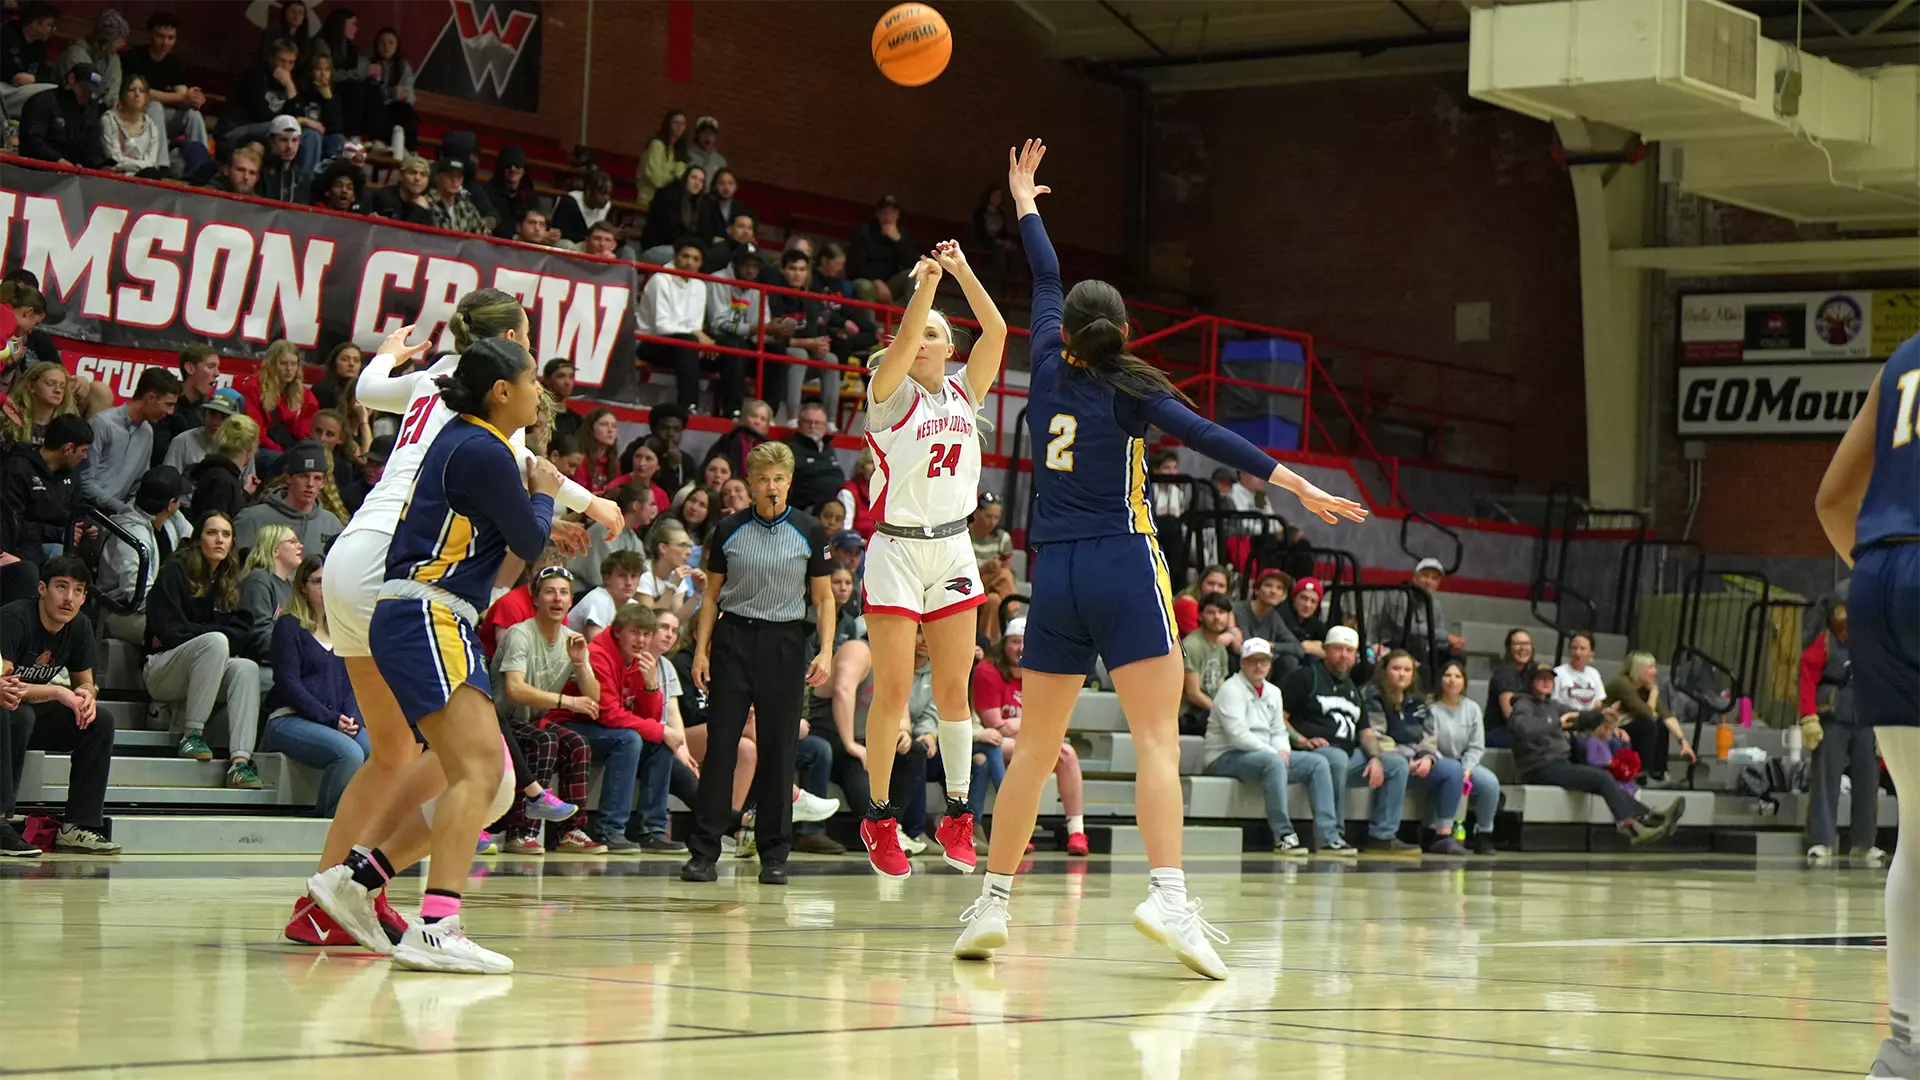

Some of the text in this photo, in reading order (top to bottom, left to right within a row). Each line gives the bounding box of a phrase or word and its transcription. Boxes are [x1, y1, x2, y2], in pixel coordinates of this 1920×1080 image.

[395, 393, 441, 451] 21
[1046, 412, 1079, 473] 2
[926, 443, 963, 478] 24
